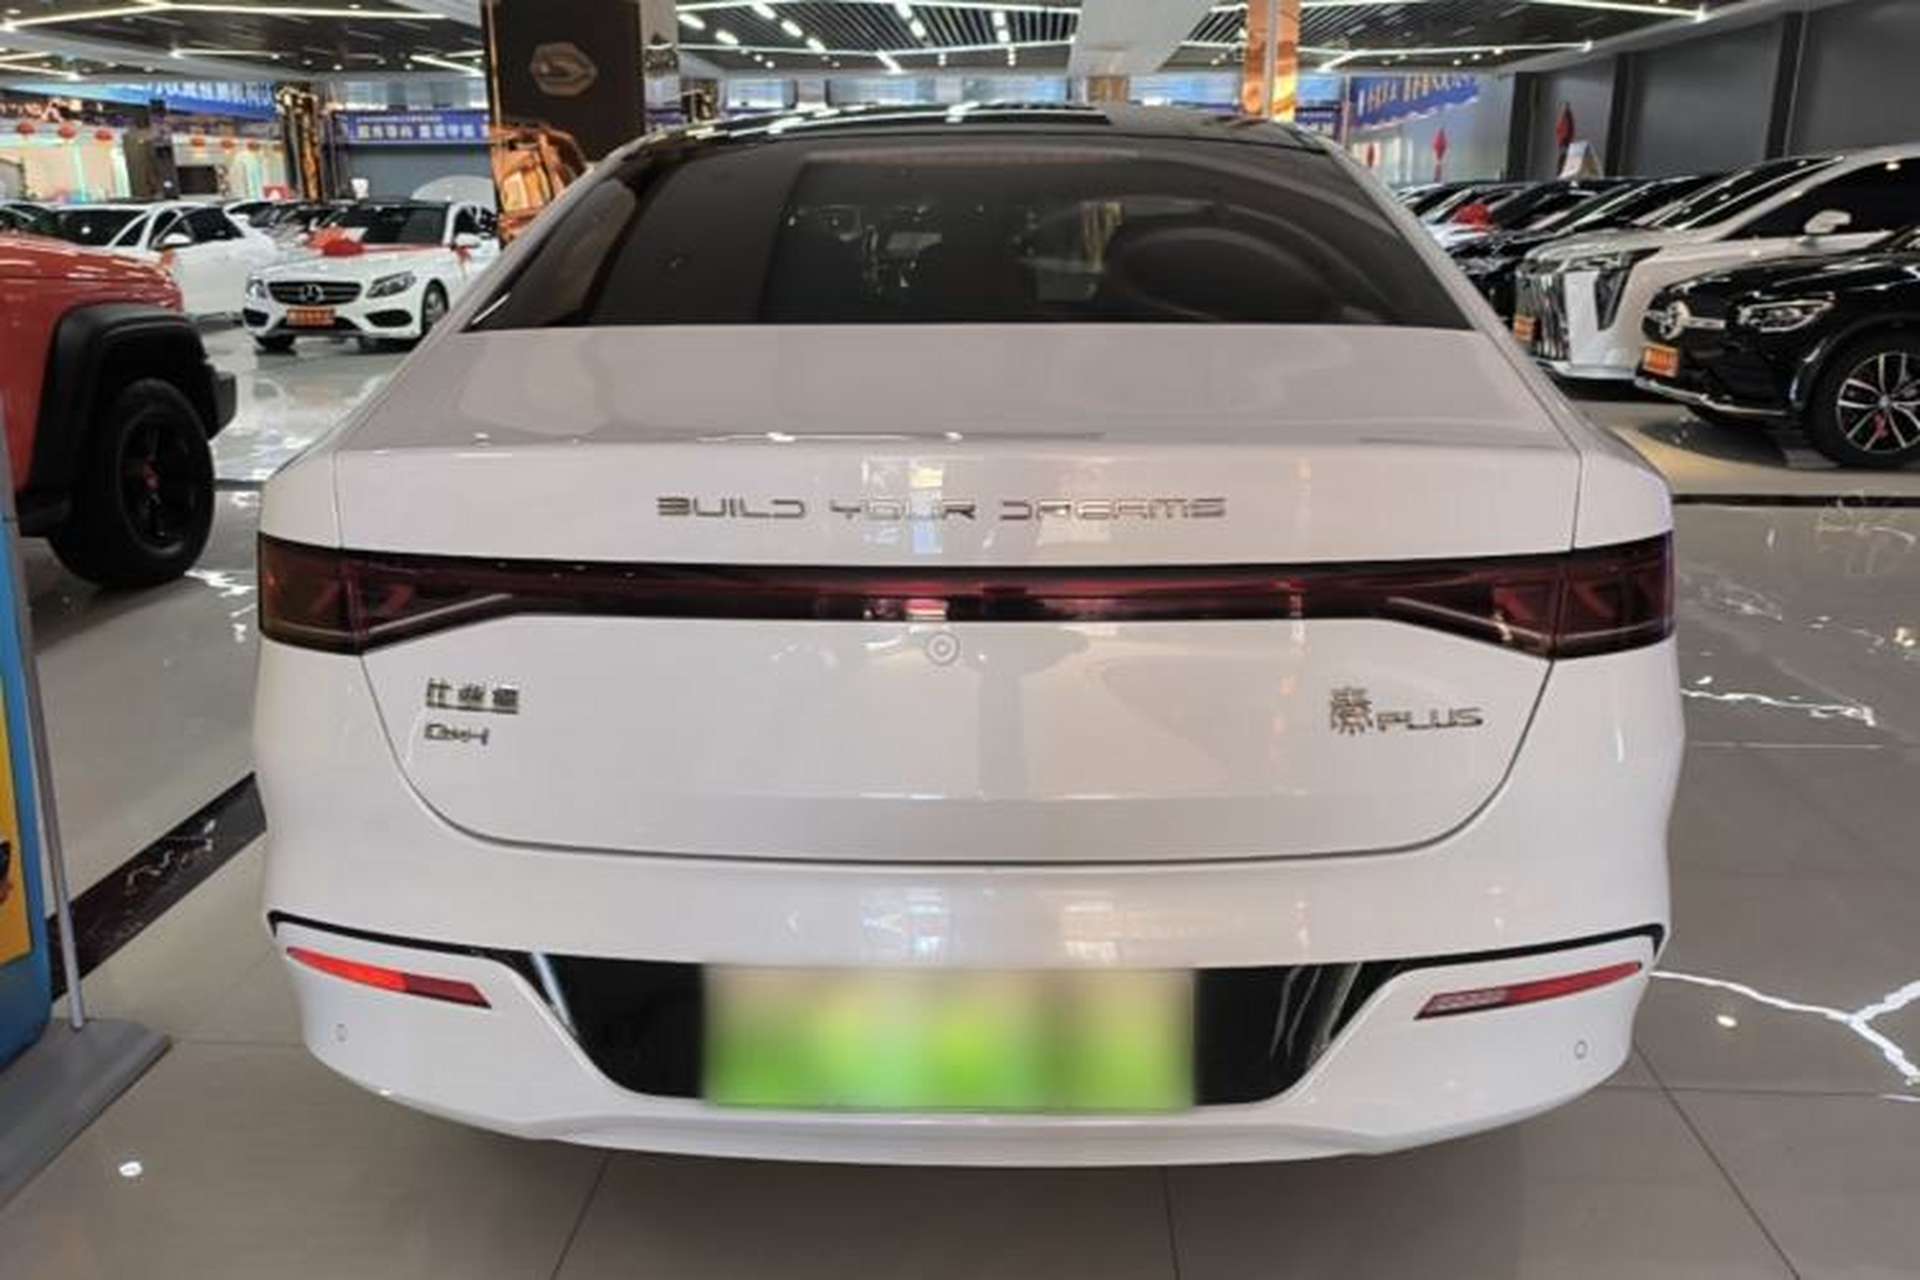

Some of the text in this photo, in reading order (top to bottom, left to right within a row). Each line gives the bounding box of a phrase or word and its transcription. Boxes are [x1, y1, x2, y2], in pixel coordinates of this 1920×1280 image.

[656, 497, 1226, 520] BUILD YOUR DREAMS
